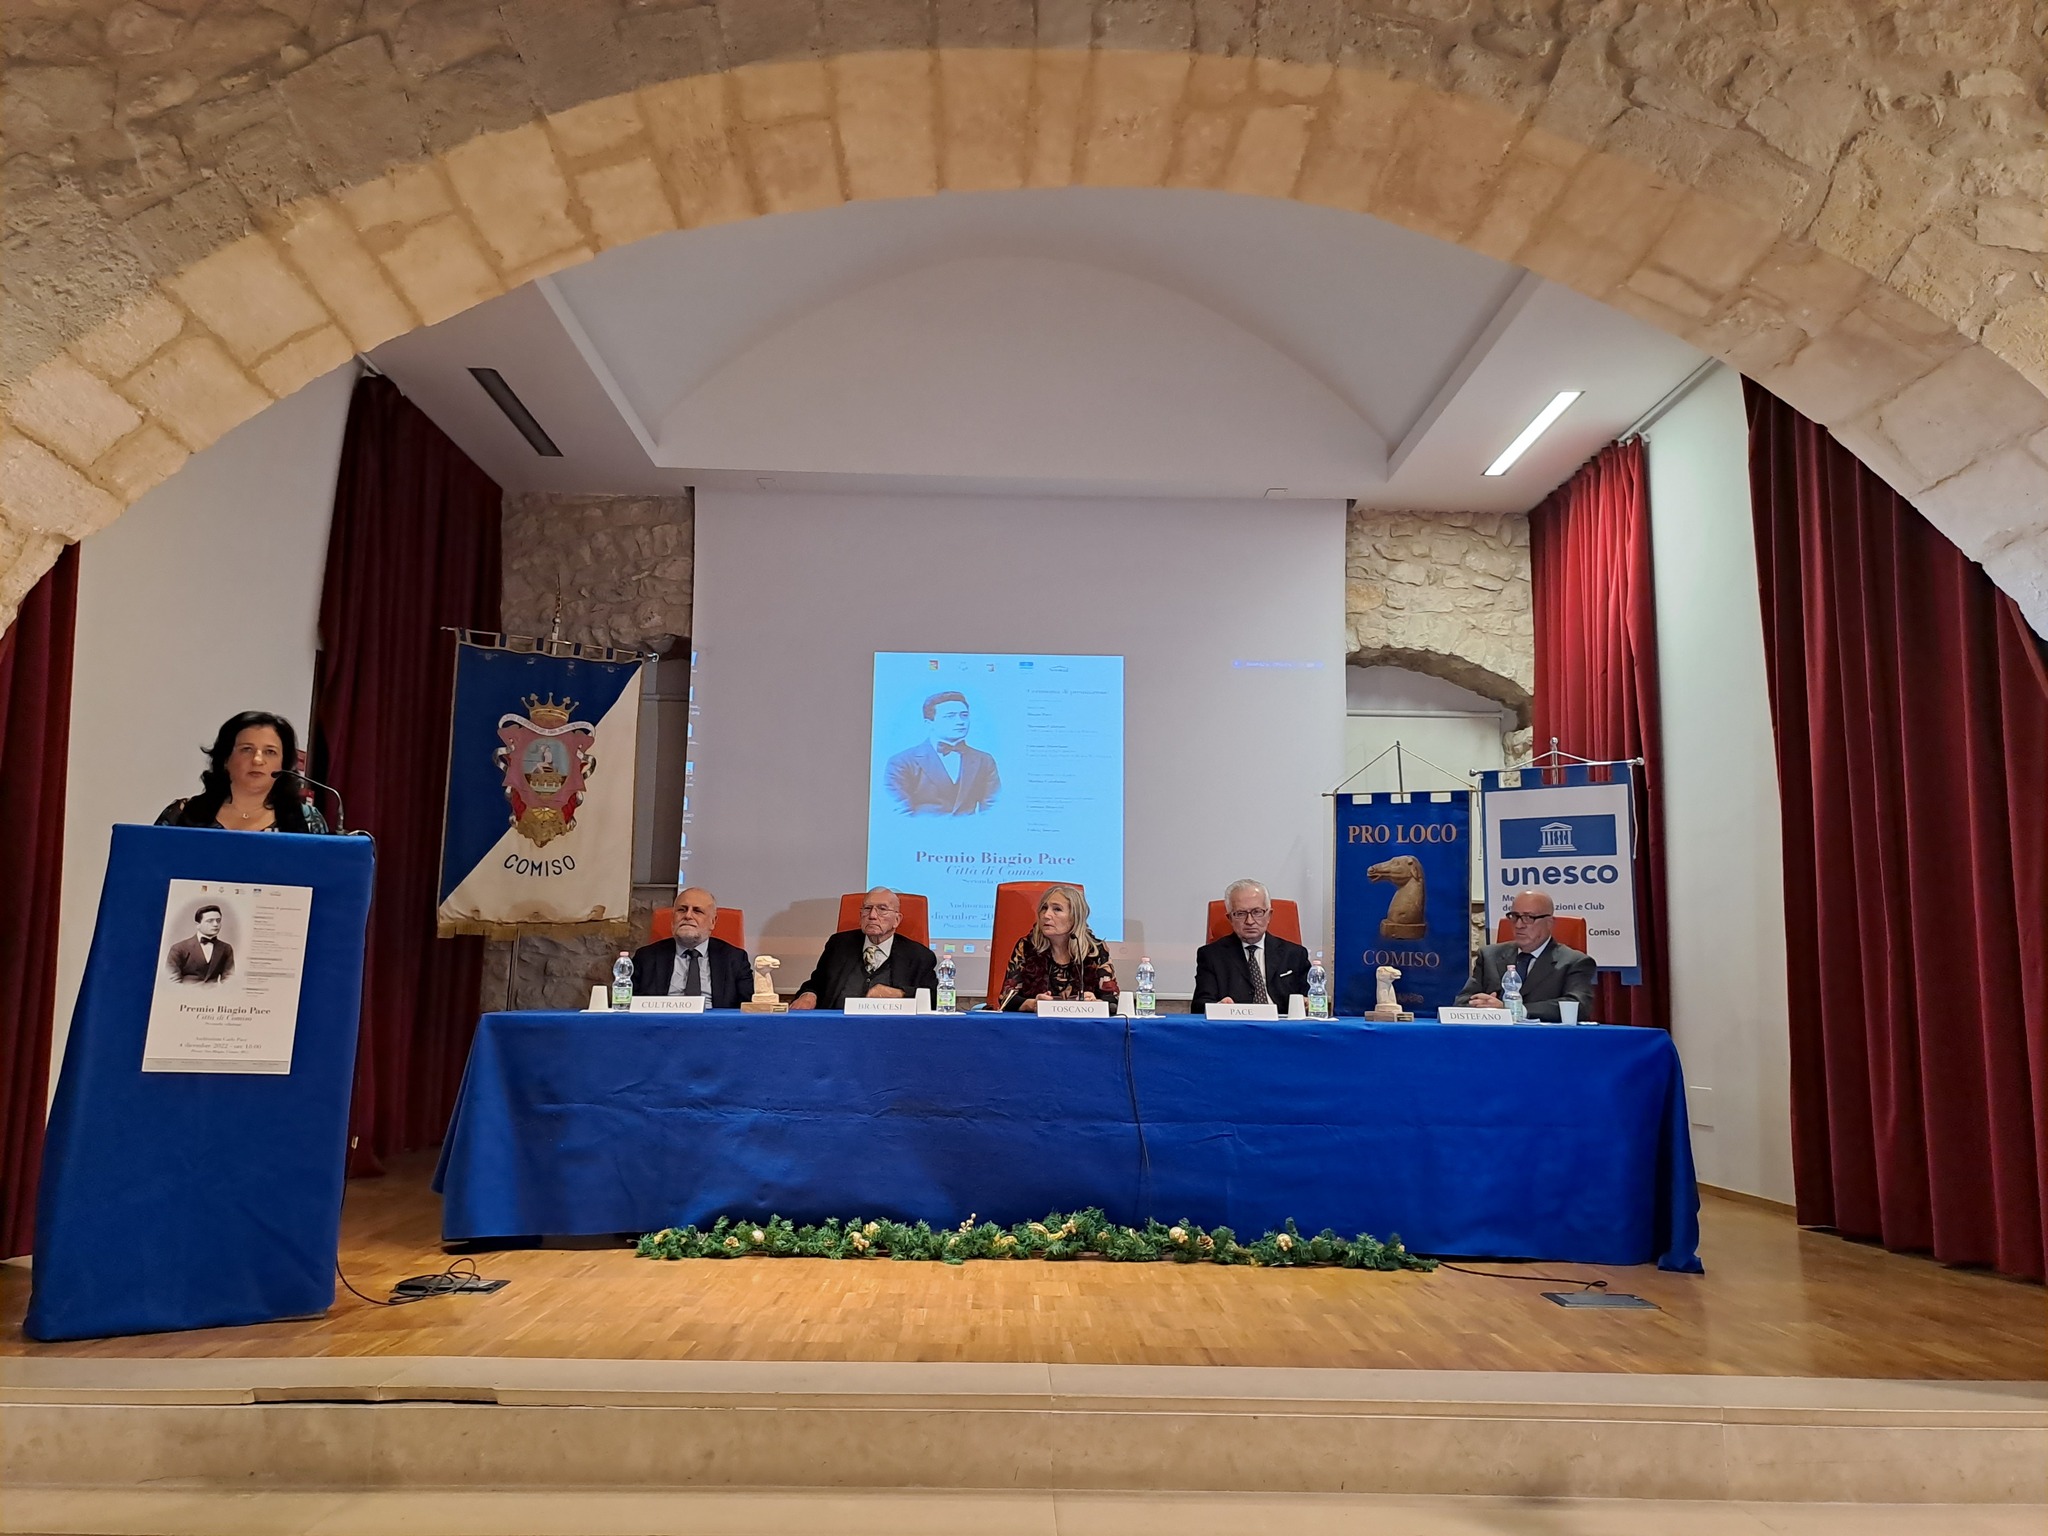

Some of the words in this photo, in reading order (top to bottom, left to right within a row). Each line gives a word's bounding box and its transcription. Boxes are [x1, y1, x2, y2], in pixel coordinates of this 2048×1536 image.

[1347, 825, 1390, 844] PRO
[1396, 823, 1457, 844] LOCO
[916, 851, 975, 863] Premio
[981, 852, 1033, 865] Biagio
[1038, 853, 1075, 865] Pace
[503, 853, 576, 877] COMISO
[982, 866, 994, 875] di
[998, 867, 1044, 876] Comiso
[1501, 864, 1618, 886] unesco
[1584, 902, 1605, 911] Club
[1588, 928, 1620, 936] Comiso
[1362, 949, 1440, 968] COMISO
[179, 1004, 214, 1013] Premio
[217, 1005, 247, 1015] Biagio
[249, 1007, 271, 1015] Pace
[641, 1001, 692, 1009] CULTRARO
[1052, 1005, 1094, 1013] TOSCANO
[1230, 1008, 1254, 1016] PACE
[1450, 1012, 1502, 1020] DISTEFANO
